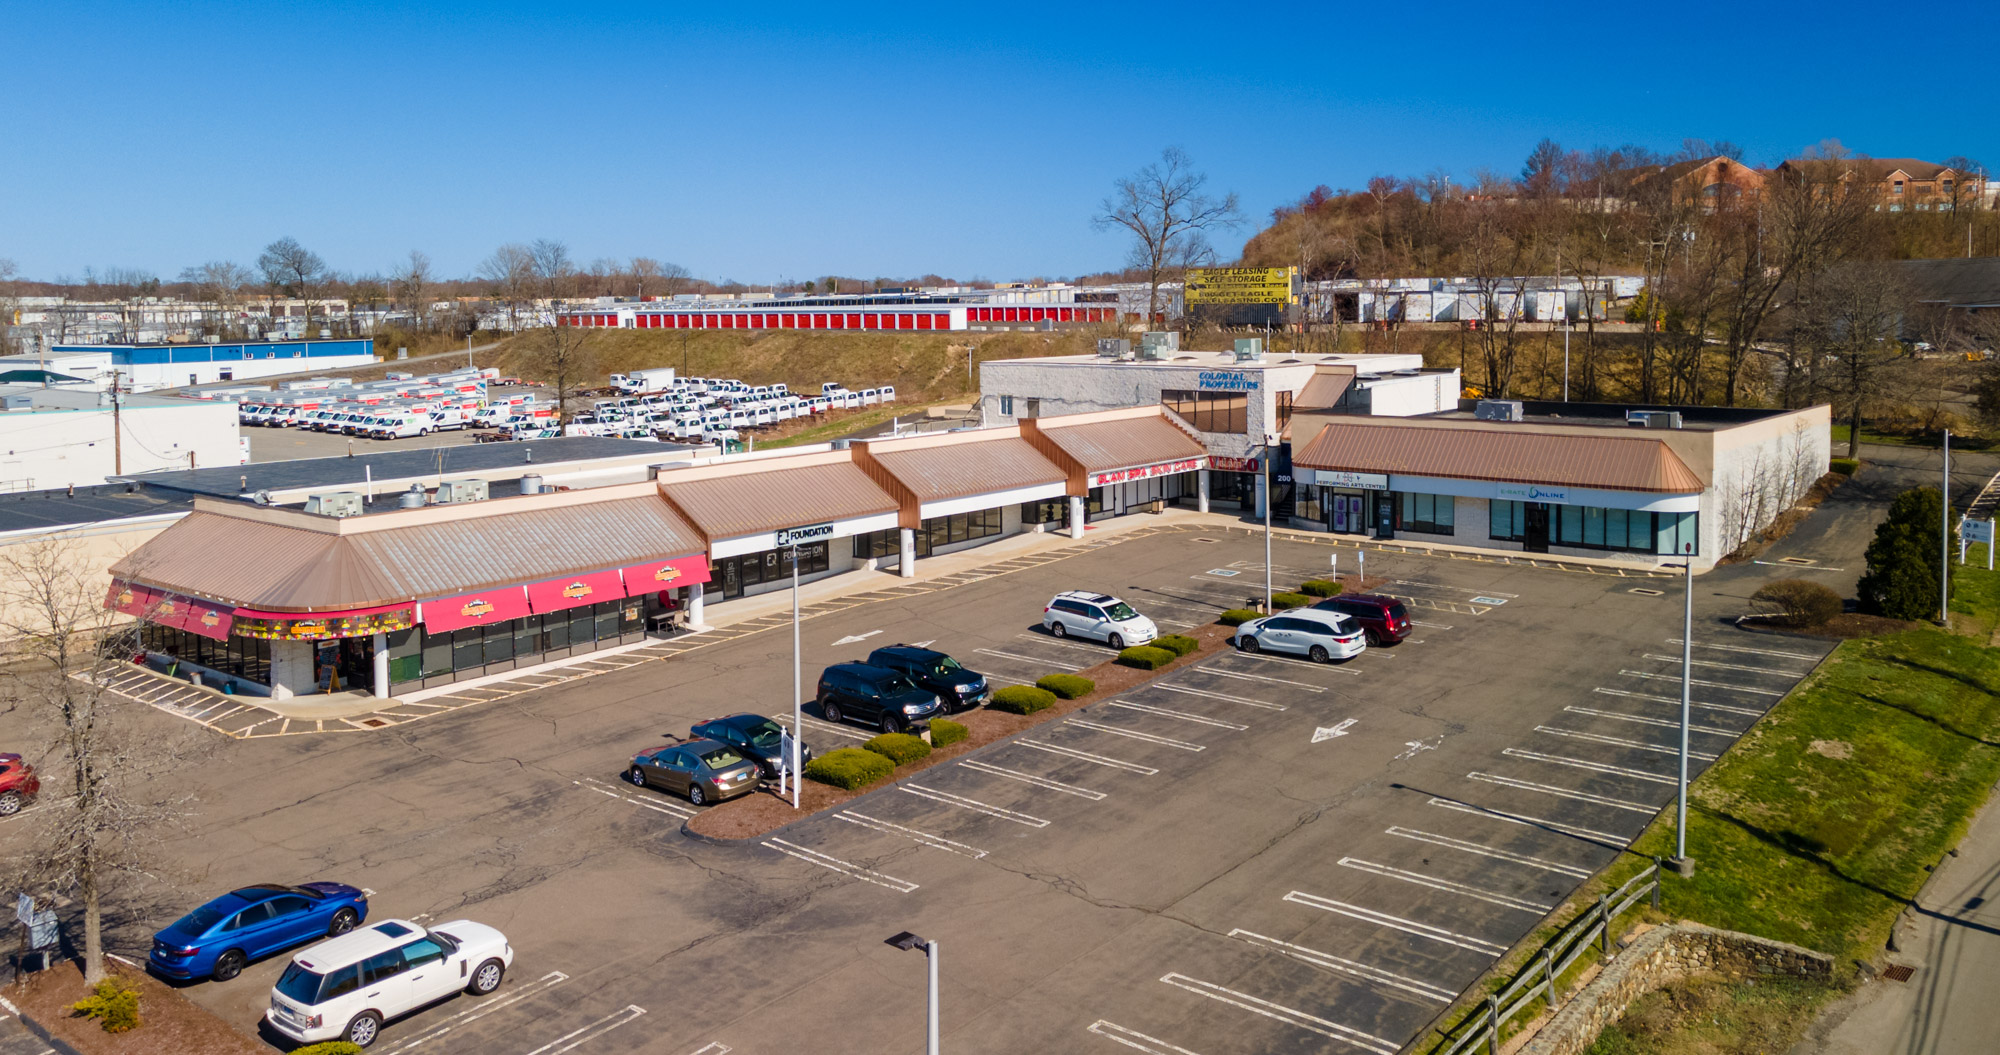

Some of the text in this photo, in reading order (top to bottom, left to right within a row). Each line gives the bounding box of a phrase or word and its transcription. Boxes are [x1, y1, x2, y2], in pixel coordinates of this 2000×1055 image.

[1232, 267, 1269, 275] LEASING
[1229, 275, 1267, 283] STORAGE
[1199, 372, 1245, 381] COLONIAL
[1199, 380, 1259, 389] PROPERTIES
[1208, 456, 1259, 472] VIDEO
[1097, 459, 1198, 485] GLAM SPA SKIN CARE
[1316, 480, 1350, 488] PERFORMING
[1528, 486, 1565, 499] ONLINE
[791, 526, 833, 540] FOUNDATION
